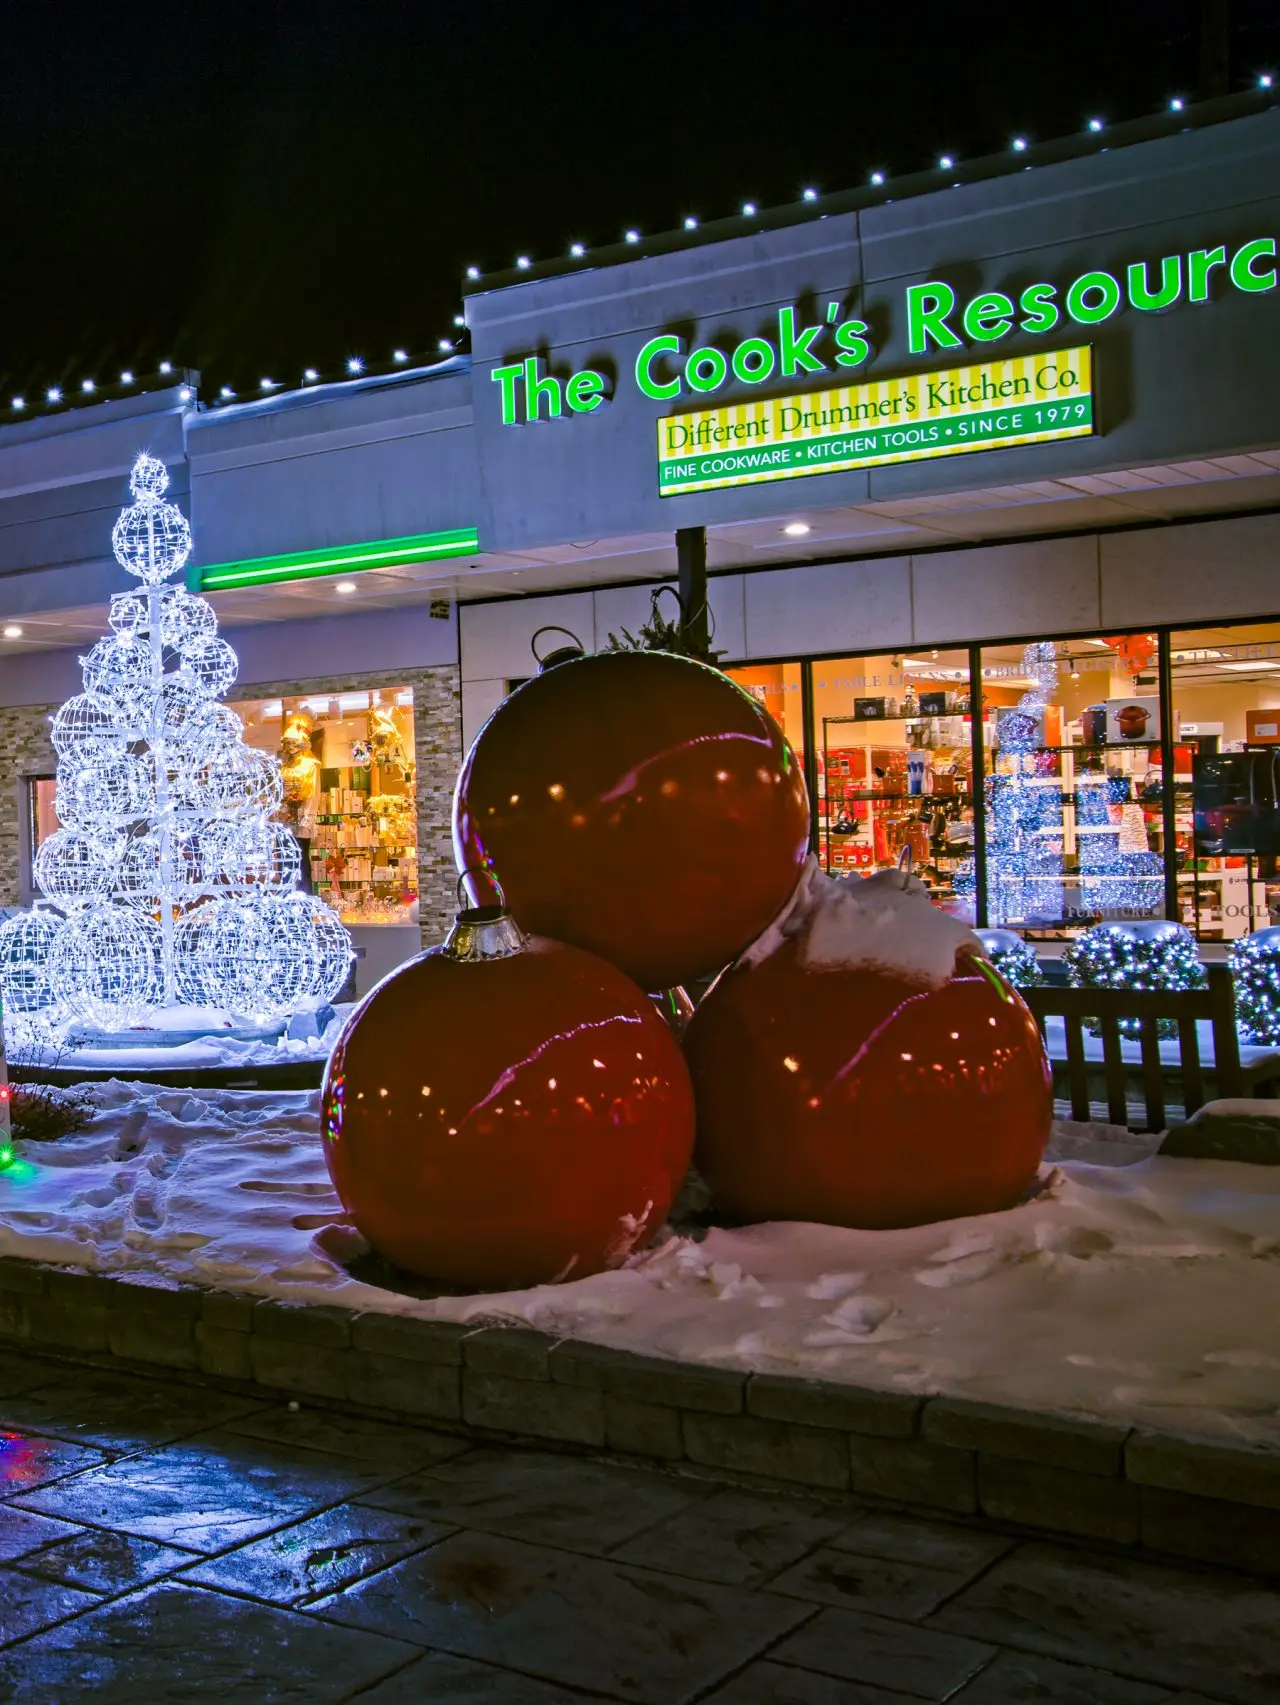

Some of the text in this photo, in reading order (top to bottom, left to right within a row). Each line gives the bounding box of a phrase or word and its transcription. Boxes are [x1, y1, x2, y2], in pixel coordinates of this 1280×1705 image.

[490, 355, 606, 426] The
[634, 301, 871, 401] Cook's
[664, 403, 1086, 480] FINE COOKWARE KITCHEN TOOLS SINCE 1979
[666, 365, 1080, 451] Different Drummer's Kitchen Co.
[834, 674, 881, 690] TABLE
[1216, 903, 1279, 918] TOOLS
